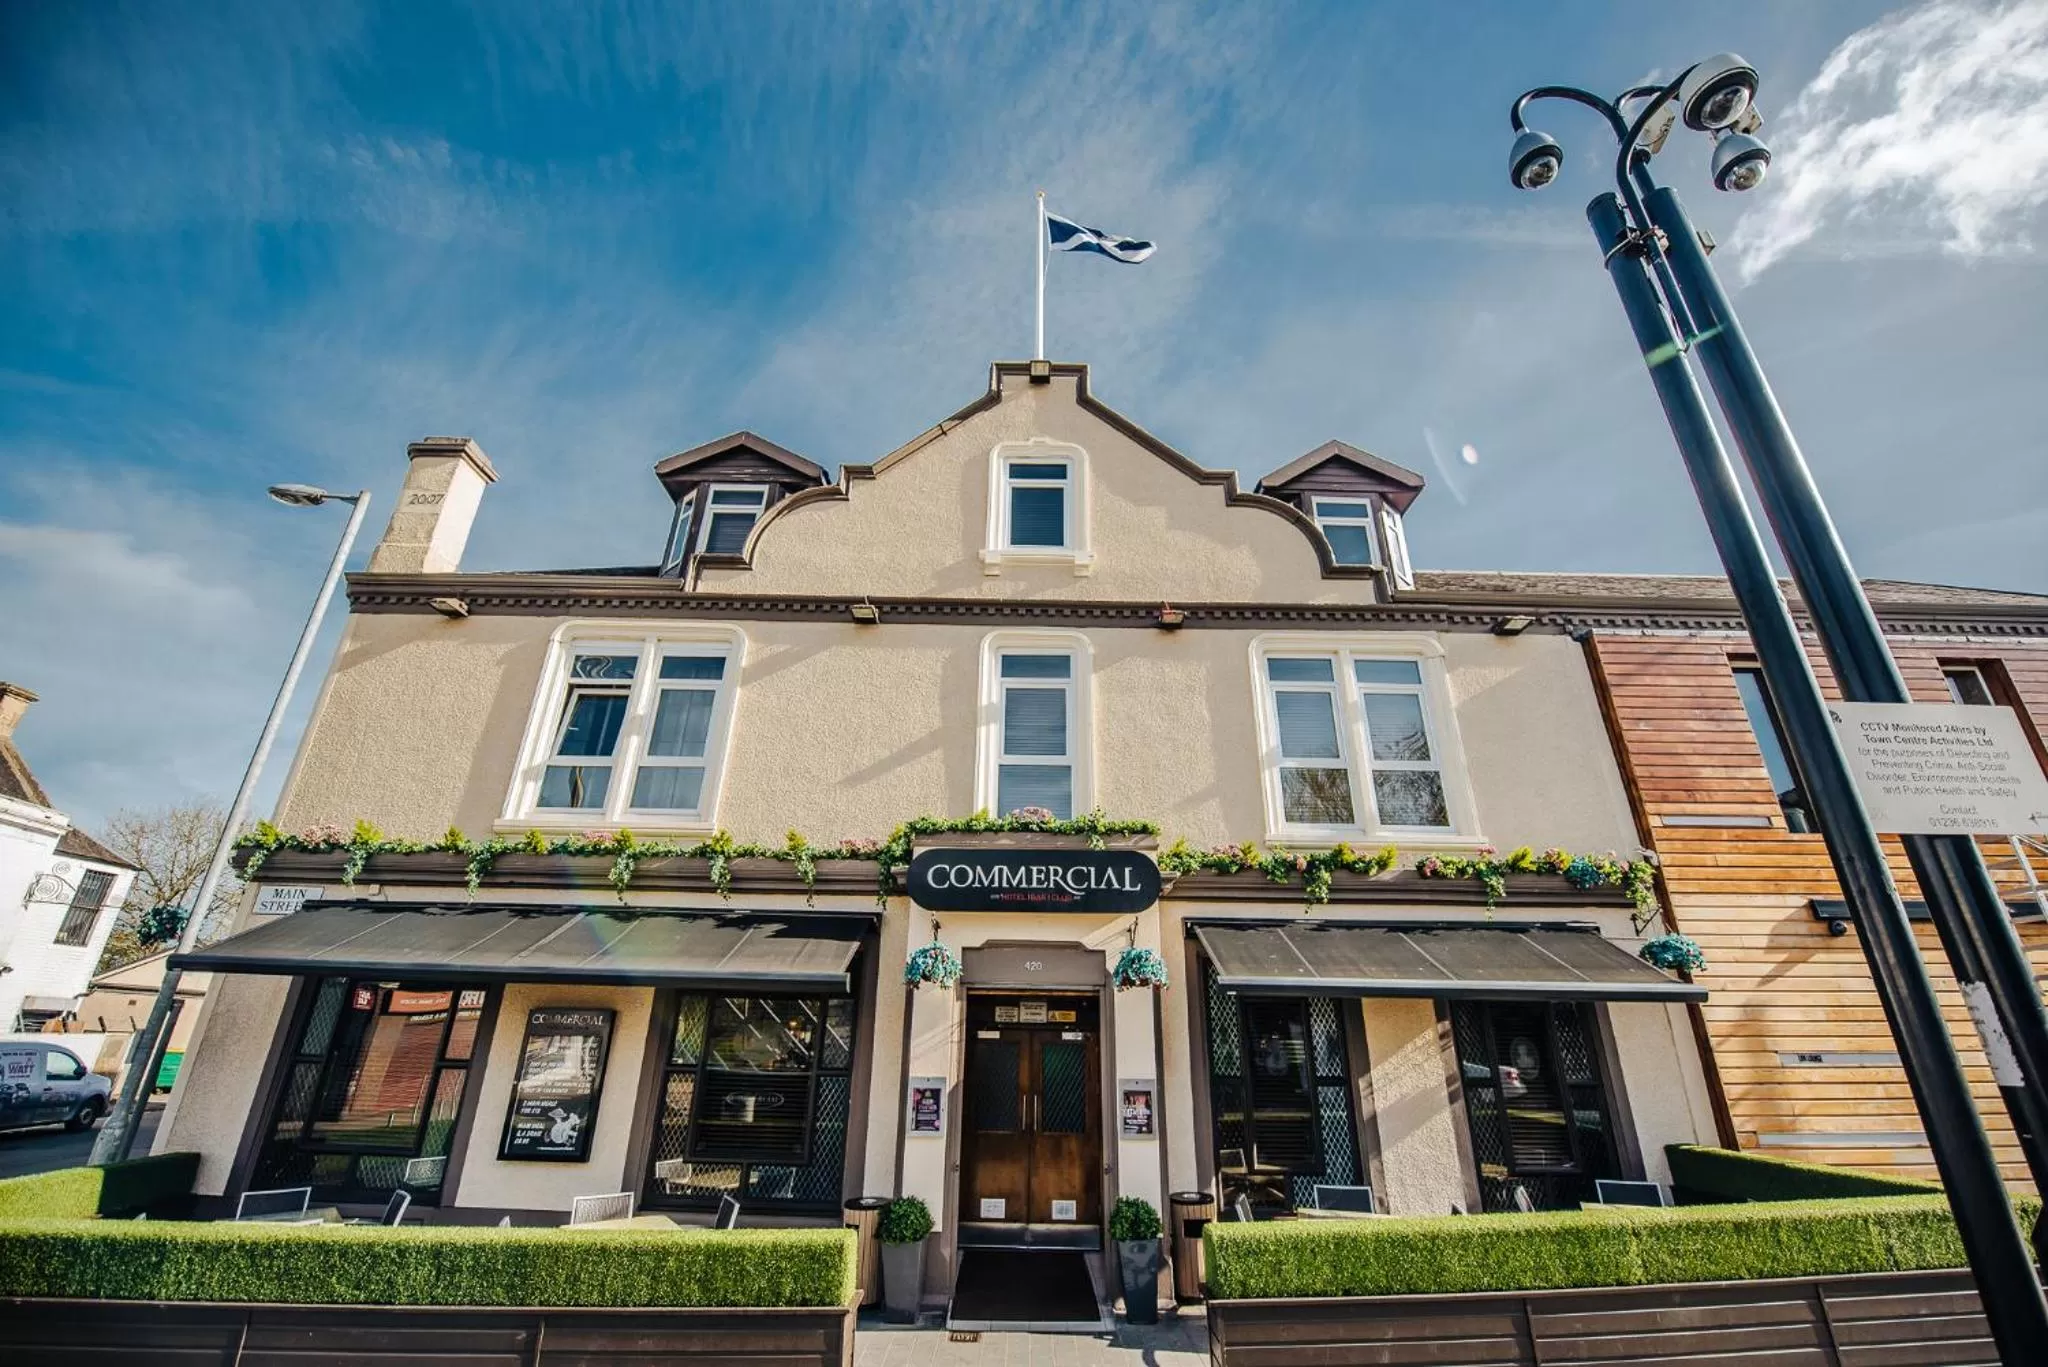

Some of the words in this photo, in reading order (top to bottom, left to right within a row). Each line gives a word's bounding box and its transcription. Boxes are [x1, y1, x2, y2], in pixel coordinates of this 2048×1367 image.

[409, 494, 445, 505] 2007
[1861, 722, 1889, 732] CCTV
[1892, 723, 1942, 733] Monitored
[1945, 725, 1972, 734] 24hrs
[1974, 726, 1986, 736] by
[1863, 734, 1892, 744] Town
[1894, 735, 1928, 745] Centre
[1930, 737, 1975, 746] Activities
[1977, 738, 1994, 747] Ltd
[1873, 748, 1889, 757] the
[1891, 749, 1934, 759] purposes
[1947, 750, 1991, 761] Detecting
[1993, 751, 2010, 760] and
[1872, 759, 1923, 771] Preventing
[1911, 772, 1978, 783] Environmental
[1980, 774, 2022, 784] Incidents
[1903, 785, 1930, 795] Public
[1934, 786, 1964, 795] Health
[1967, 787, 1985, 796] and
[1986, 787, 2017, 798] Safety
[1939, 804, 1978, 814] Contact
[926, 864, 1142, 895] COMMERCIAL
[273, 888, 307, 899] MAIN
[261, 900, 302, 912] STREE
[1024, 960, 1043, 972] 420
